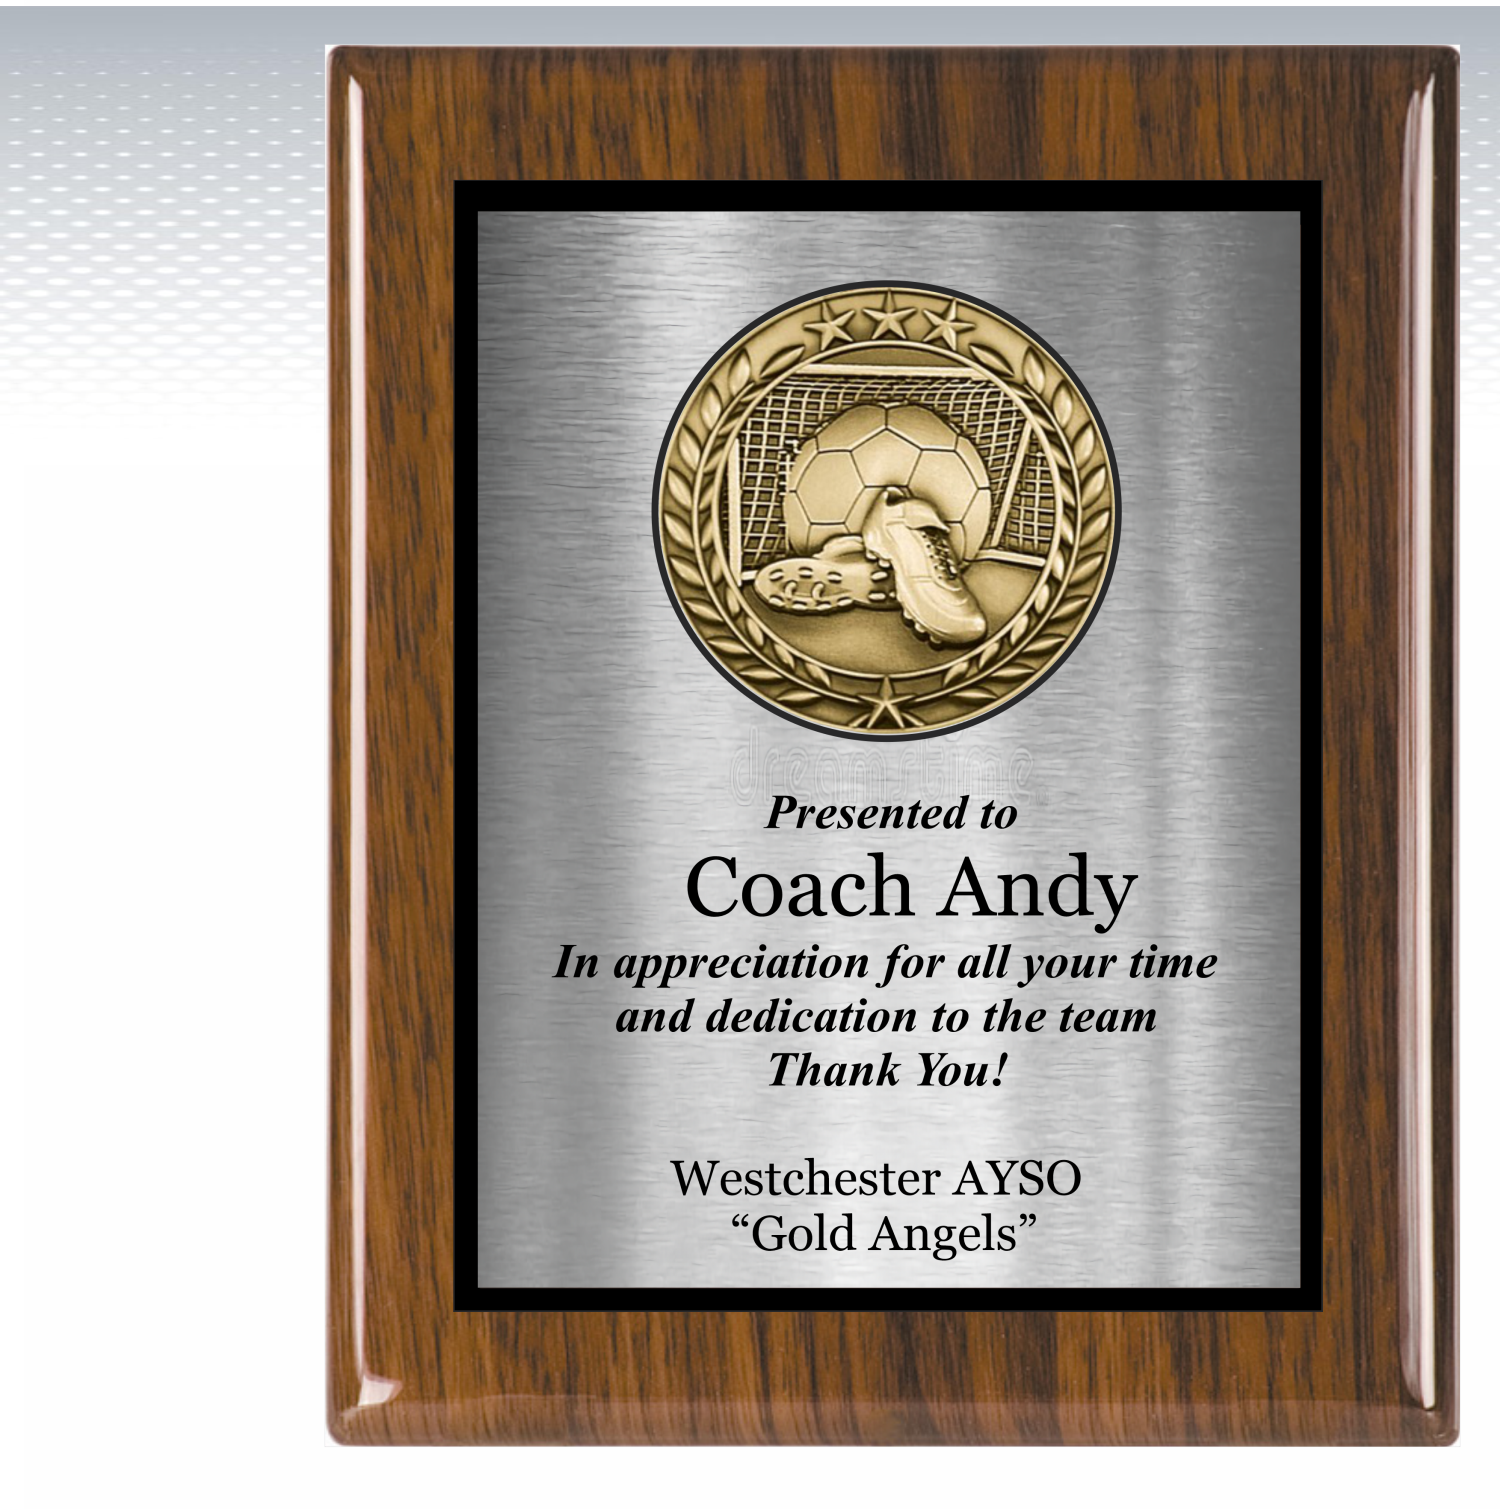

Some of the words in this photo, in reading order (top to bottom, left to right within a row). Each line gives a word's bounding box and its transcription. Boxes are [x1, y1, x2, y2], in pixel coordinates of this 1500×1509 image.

[763, 794, 970, 830] Presented
[980, 799, 1018, 830] to
[687, 851, 916, 918] Coach
[935, 851, 1139, 934] Andy
[551, 944, 598, 978] In
[613, 943, 869, 989] appreciation
[875, 943, 946, 989] for
[957, 943, 1012, 979] all
[1017, 954, 1118, 989] your
[1129, 943, 1218, 979] time
[615, 998, 695, 1033] and
[706, 998, 916, 1033] dedication
[931, 1003, 969, 1033] to
[983, 998, 1047, 1033] the
[1059, 1003, 1156, 1033] team
[770, 1052, 902, 1087] Thank
[918, 1052, 1008, 1087] You!
[669, 1157, 942, 1196] Westchester
[951, 1159, 1081, 1196] AYSO
